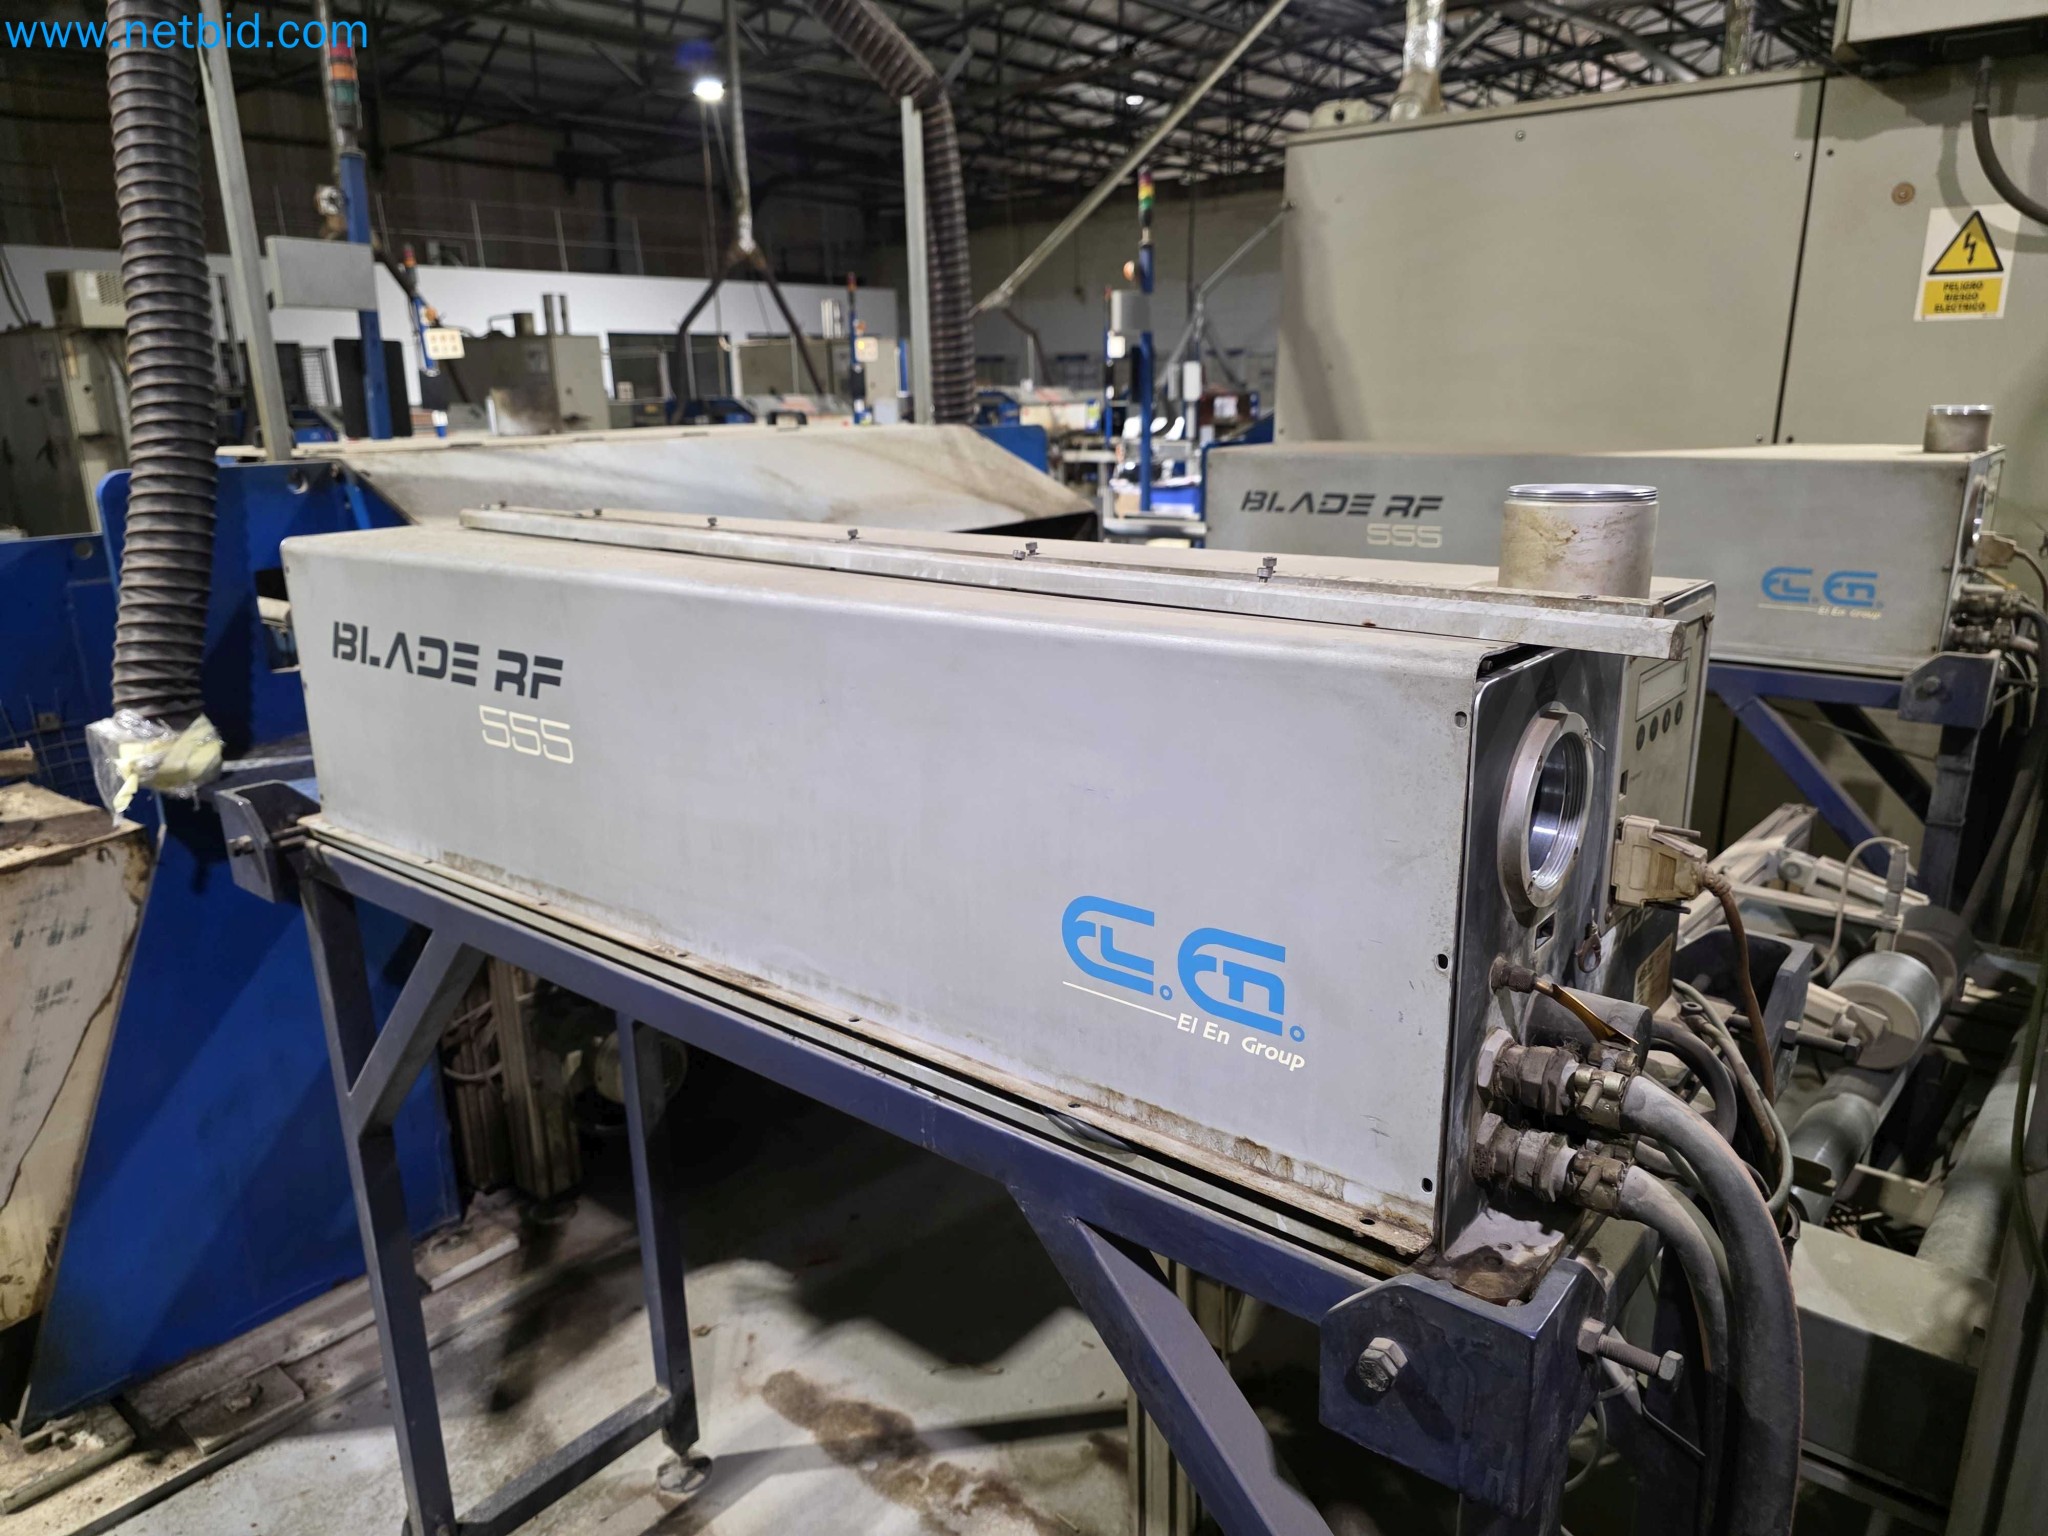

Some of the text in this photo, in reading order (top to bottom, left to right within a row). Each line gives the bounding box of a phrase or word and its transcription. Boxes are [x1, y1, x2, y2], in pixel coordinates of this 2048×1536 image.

[1943, 281, 1984, 291] PELIGRO
[1241, 490, 1444, 518] BLADE RF
[333, 621, 564, 699] BLADE RF
[479, 705, 574, 764] 555
[1176, 1012, 1306, 1072] El En Group
